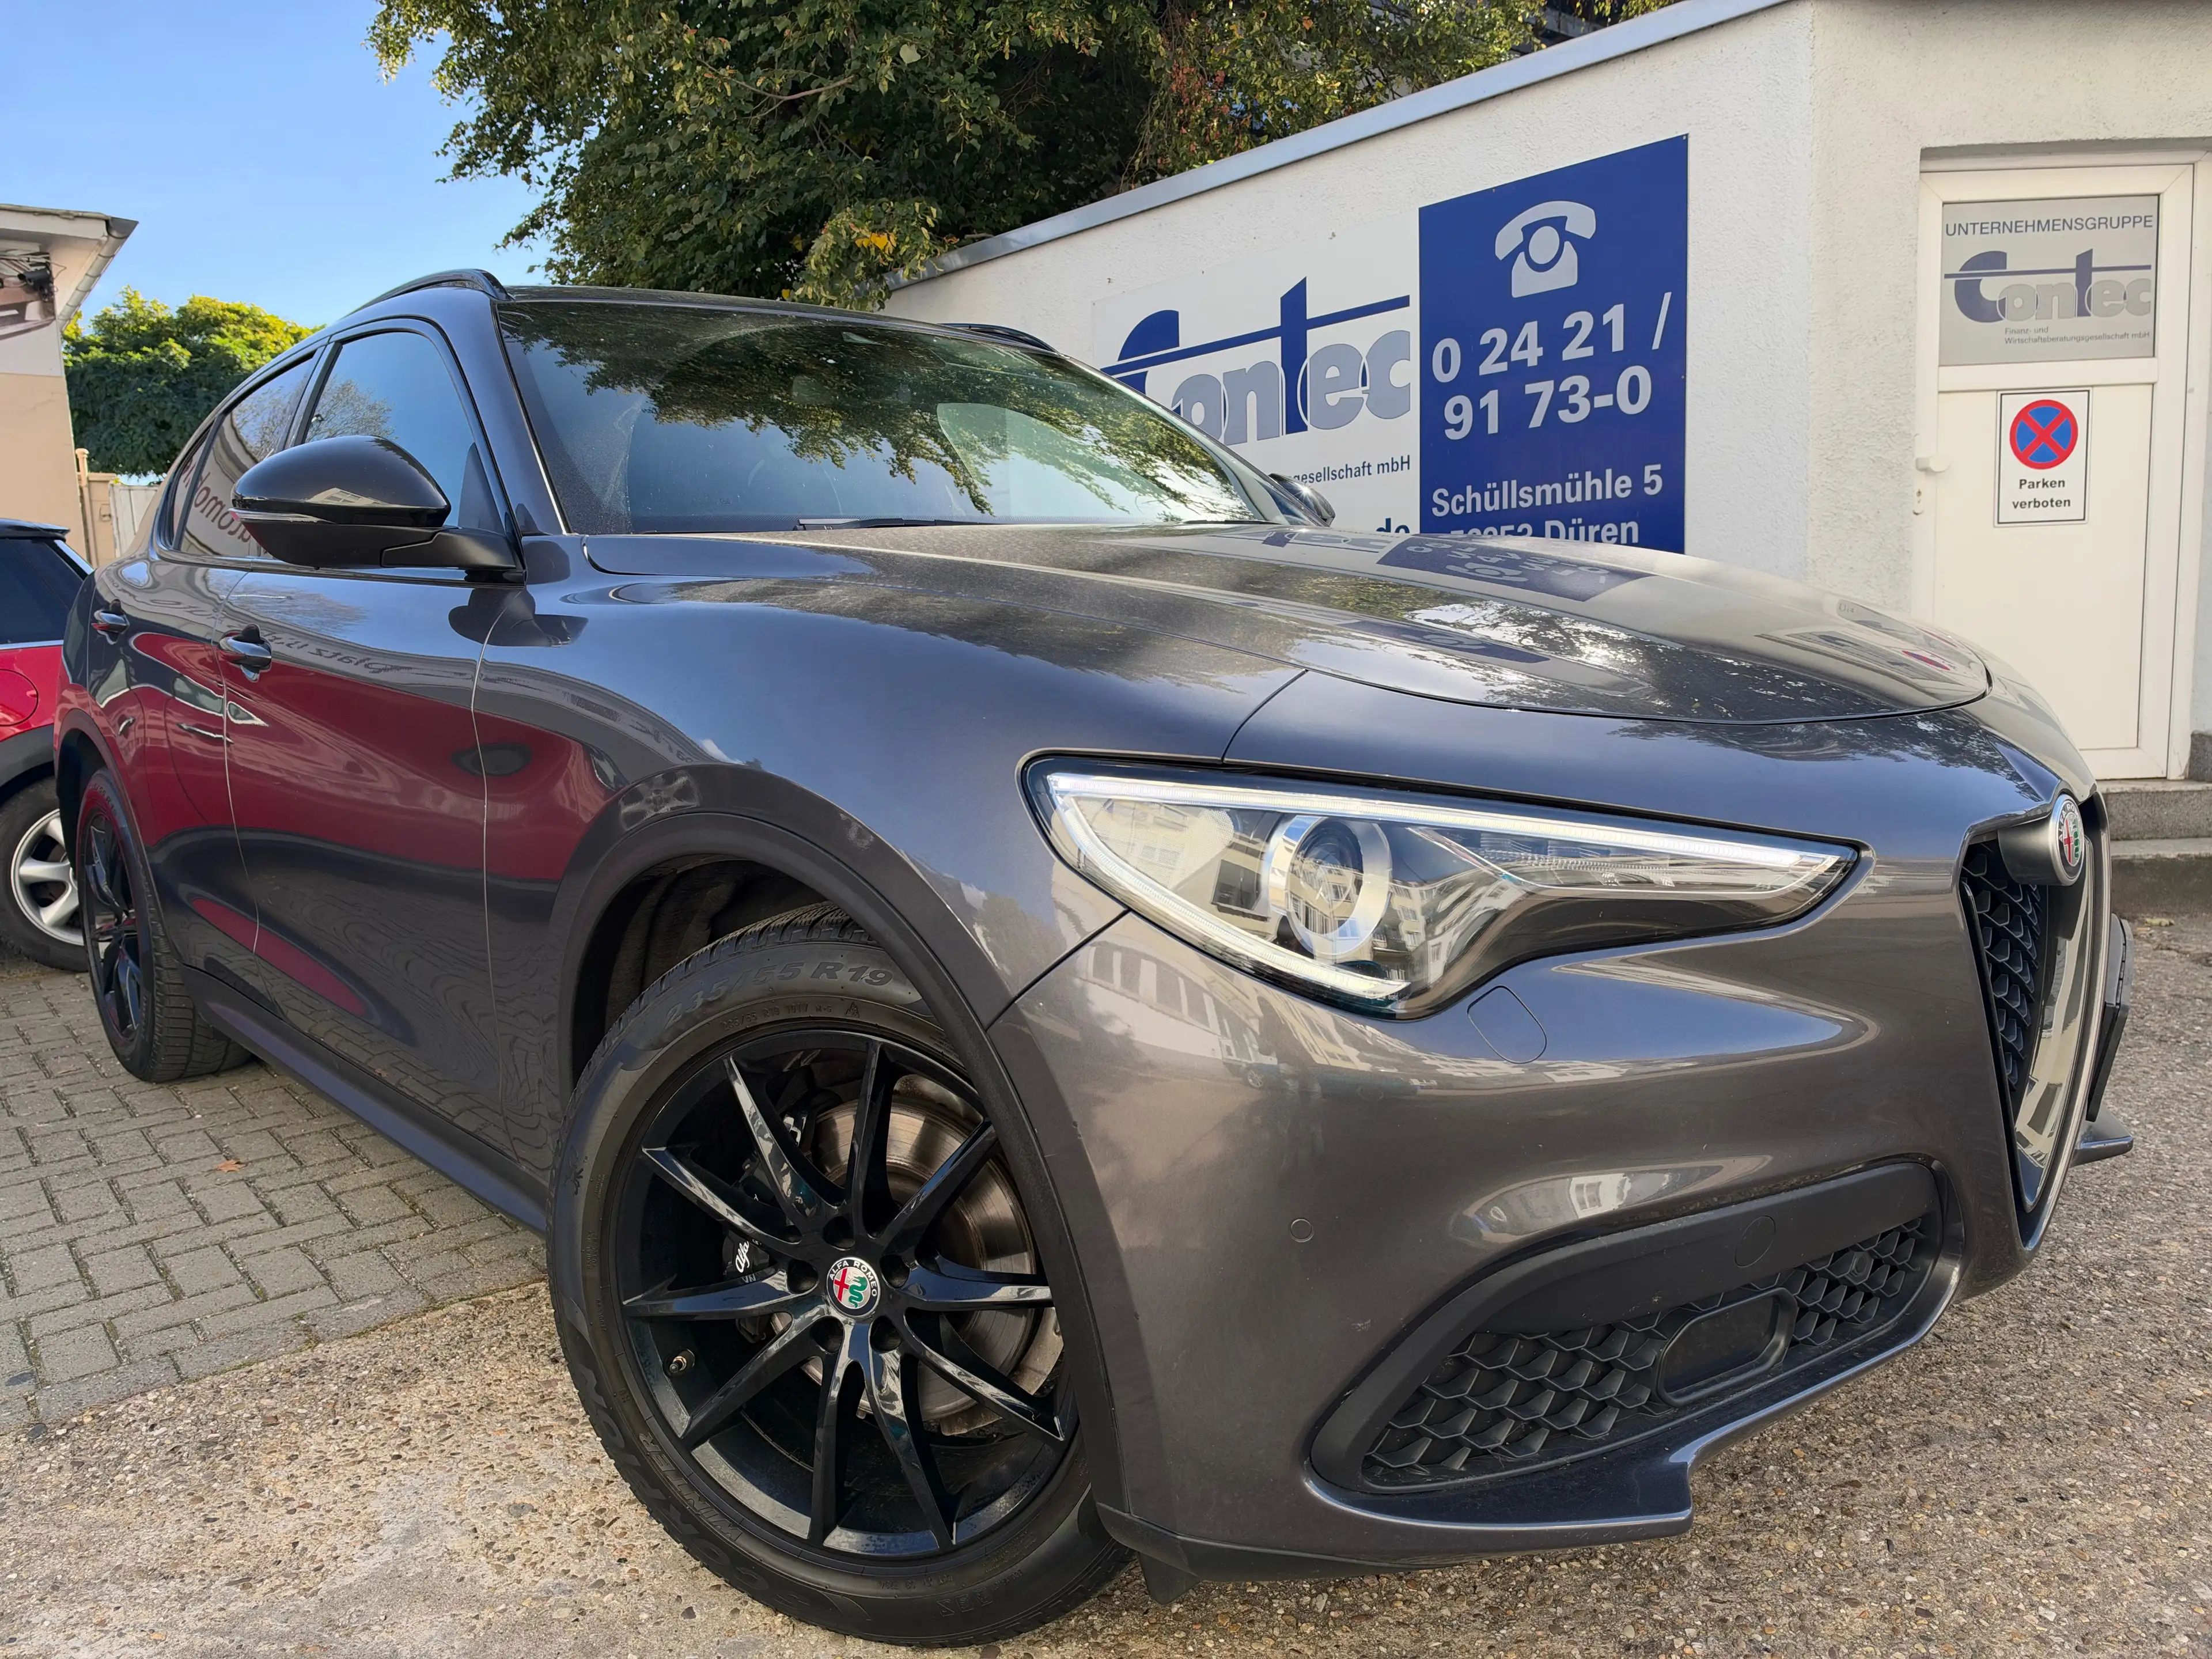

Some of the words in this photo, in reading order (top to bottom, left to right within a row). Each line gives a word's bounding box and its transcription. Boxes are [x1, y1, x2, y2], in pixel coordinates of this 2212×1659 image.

[1945, 215, 2153, 236] UNTERNEHMENSGRUPPE
[1944, 248, 2152, 323] Contec
[1431, 338, 1461, 383] 0
[1479, 321, 1543, 376] 24
[1561, 304, 1624, 361] 21
[2005, 327, 2032, 335] Finanz-
[2005, 332, 2129, 344] Wirtschaftsberatungsgesellschaft
[1444, 394, 1498, 440] 91
[1524, 366, 1652, 429] 73-0
[1377, 454, 1410, 474] mbH
[1431, 468, 1633, 517] Schüllsmühle
[1643, 464, 1662, 495] 5
[2019, 478, 2066, 489] Parken
[2012, 497, 2071, 509] verboten
[1544, 518, 1639, 544] Düren
[2058, 810, 2067, 843] ALFA
[664, 961, 806, 1030] 235/55
[830, 1260, 849, 1281] ALFA
[853, 1260, 877, 1297] ROMEO
[638, 1431, 743, 1542] WINTER
